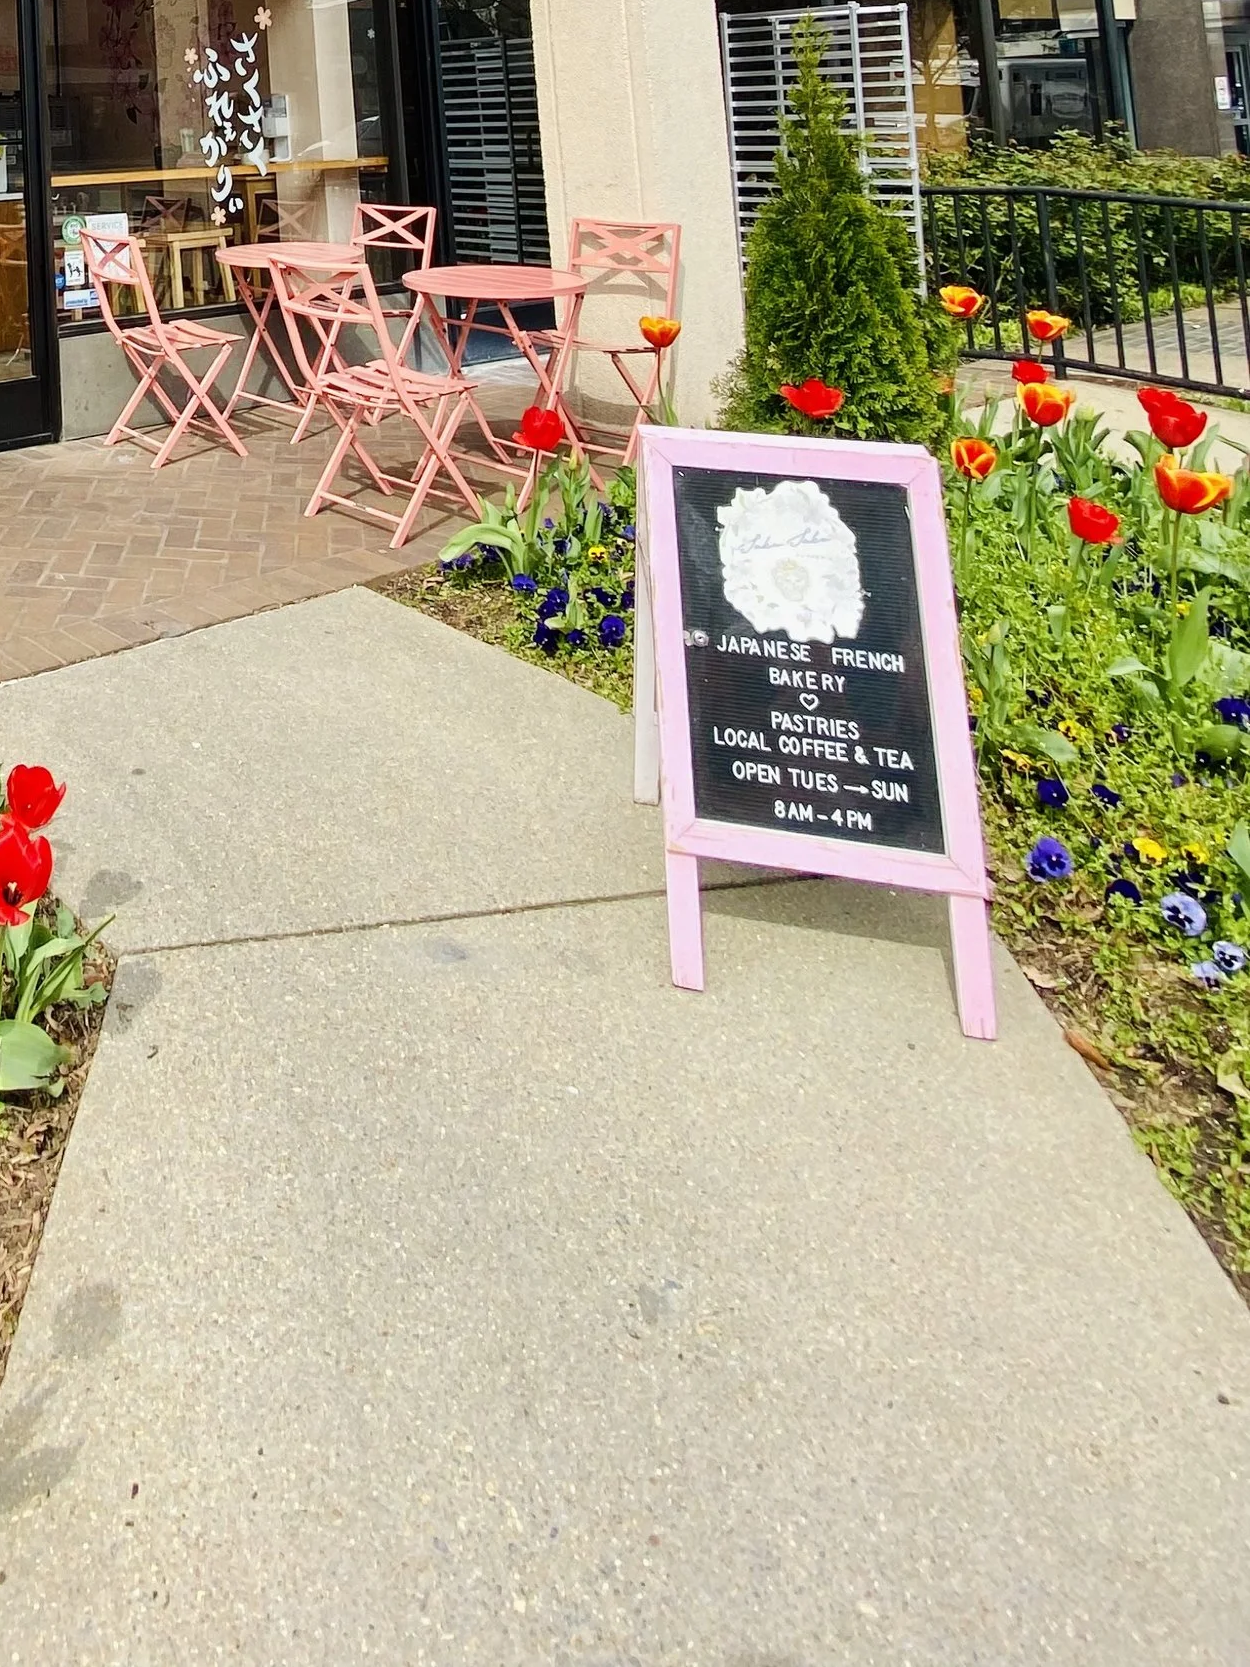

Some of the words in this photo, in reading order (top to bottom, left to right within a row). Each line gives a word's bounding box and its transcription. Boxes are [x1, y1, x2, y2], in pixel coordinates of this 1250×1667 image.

[230, 32, 268, 177] さくさく
[716, 634, 812, 663] JAPANESE
[831, 647, 905, 673] FRENCH
[768, 667, 846, 693] BAKERY
[770, 710, 861, 740] PASTRIES
[713, 726, 772, 752] LOCAL
[778, 735, 849, 762] COFFEE
[854, 745, 870, 765] &
[873, 746, 915, 771] TEA
[731, 760, 781, 785] OPEN
[787, 767, 839, 793] TUES
[871, 780, 910, 804] SUN
